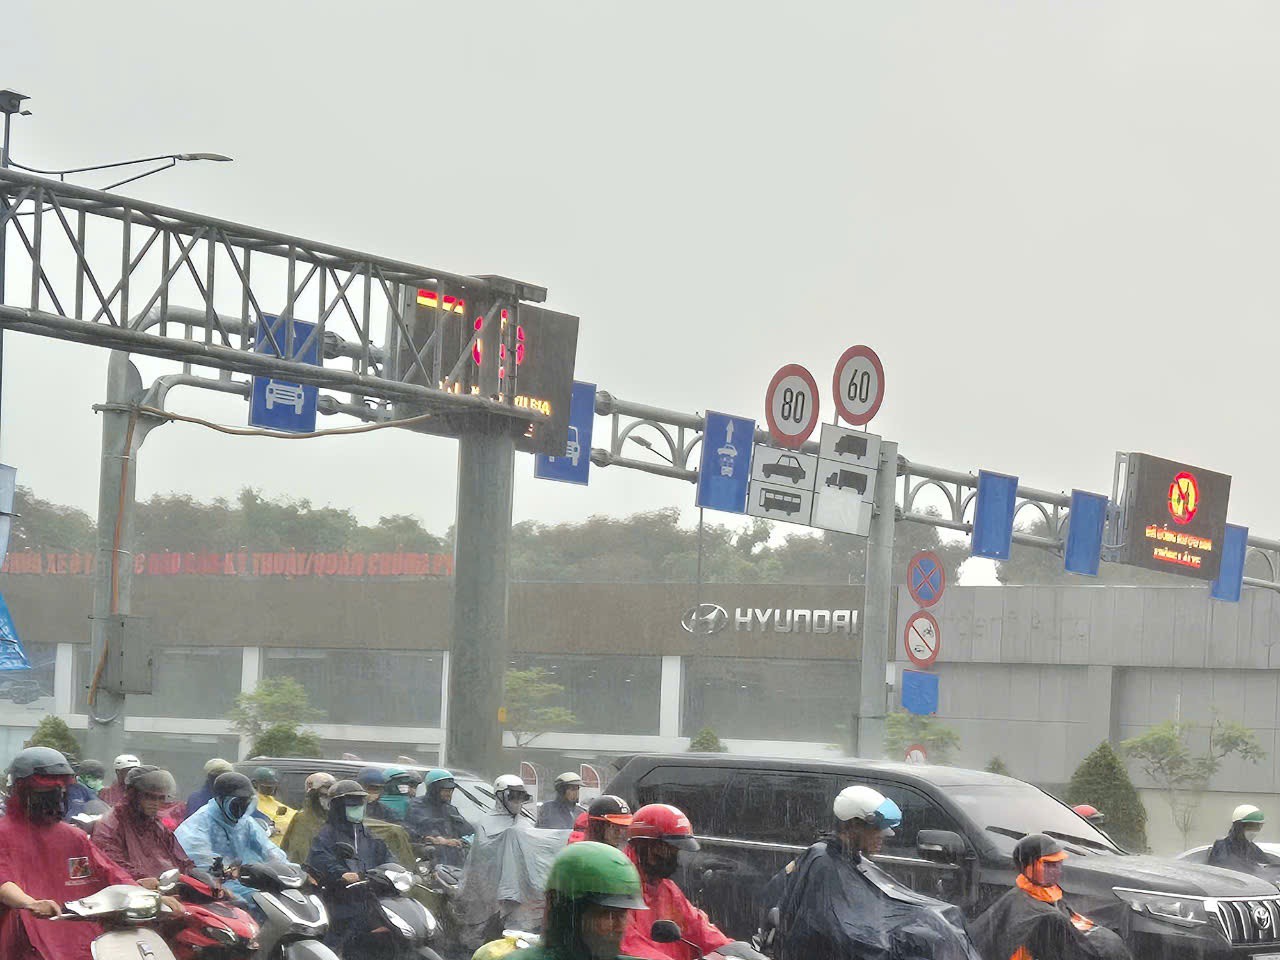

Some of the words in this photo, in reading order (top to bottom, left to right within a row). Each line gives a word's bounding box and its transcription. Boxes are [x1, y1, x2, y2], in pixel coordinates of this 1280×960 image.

[847, 368, 871, 404] 60
[781, 387, 806, 424] 80
[734, 607, 859, 634] HYUNDAI
